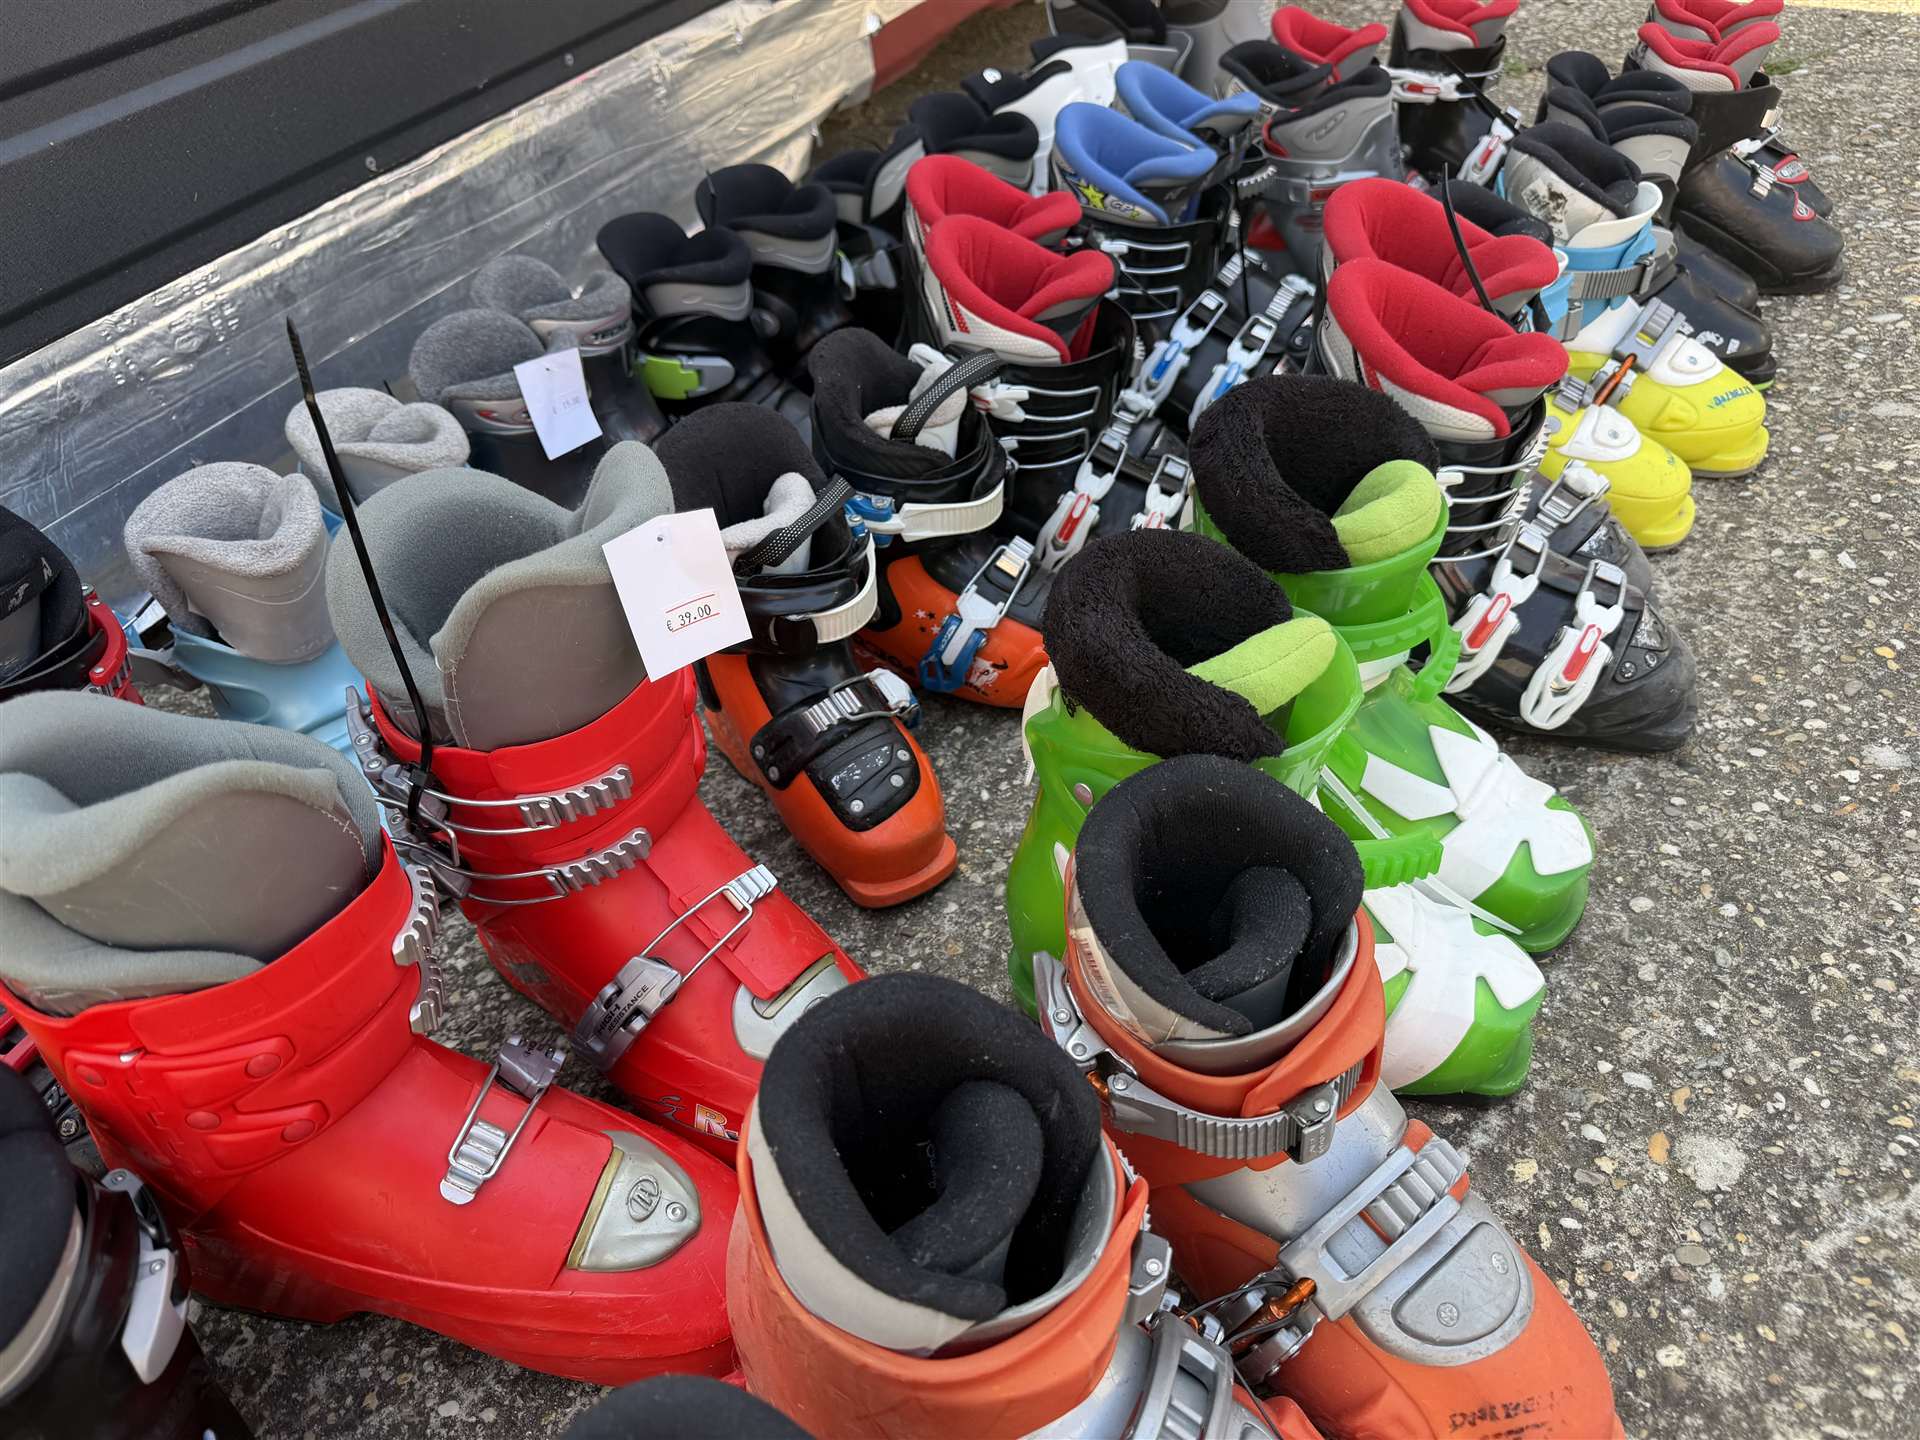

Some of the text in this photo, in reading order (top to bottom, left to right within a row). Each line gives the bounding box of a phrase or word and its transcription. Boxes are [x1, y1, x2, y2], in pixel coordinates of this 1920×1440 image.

[666, 603, 712, 632] € 39.00
[607, 984, 650, 1033] RESISTANCE
